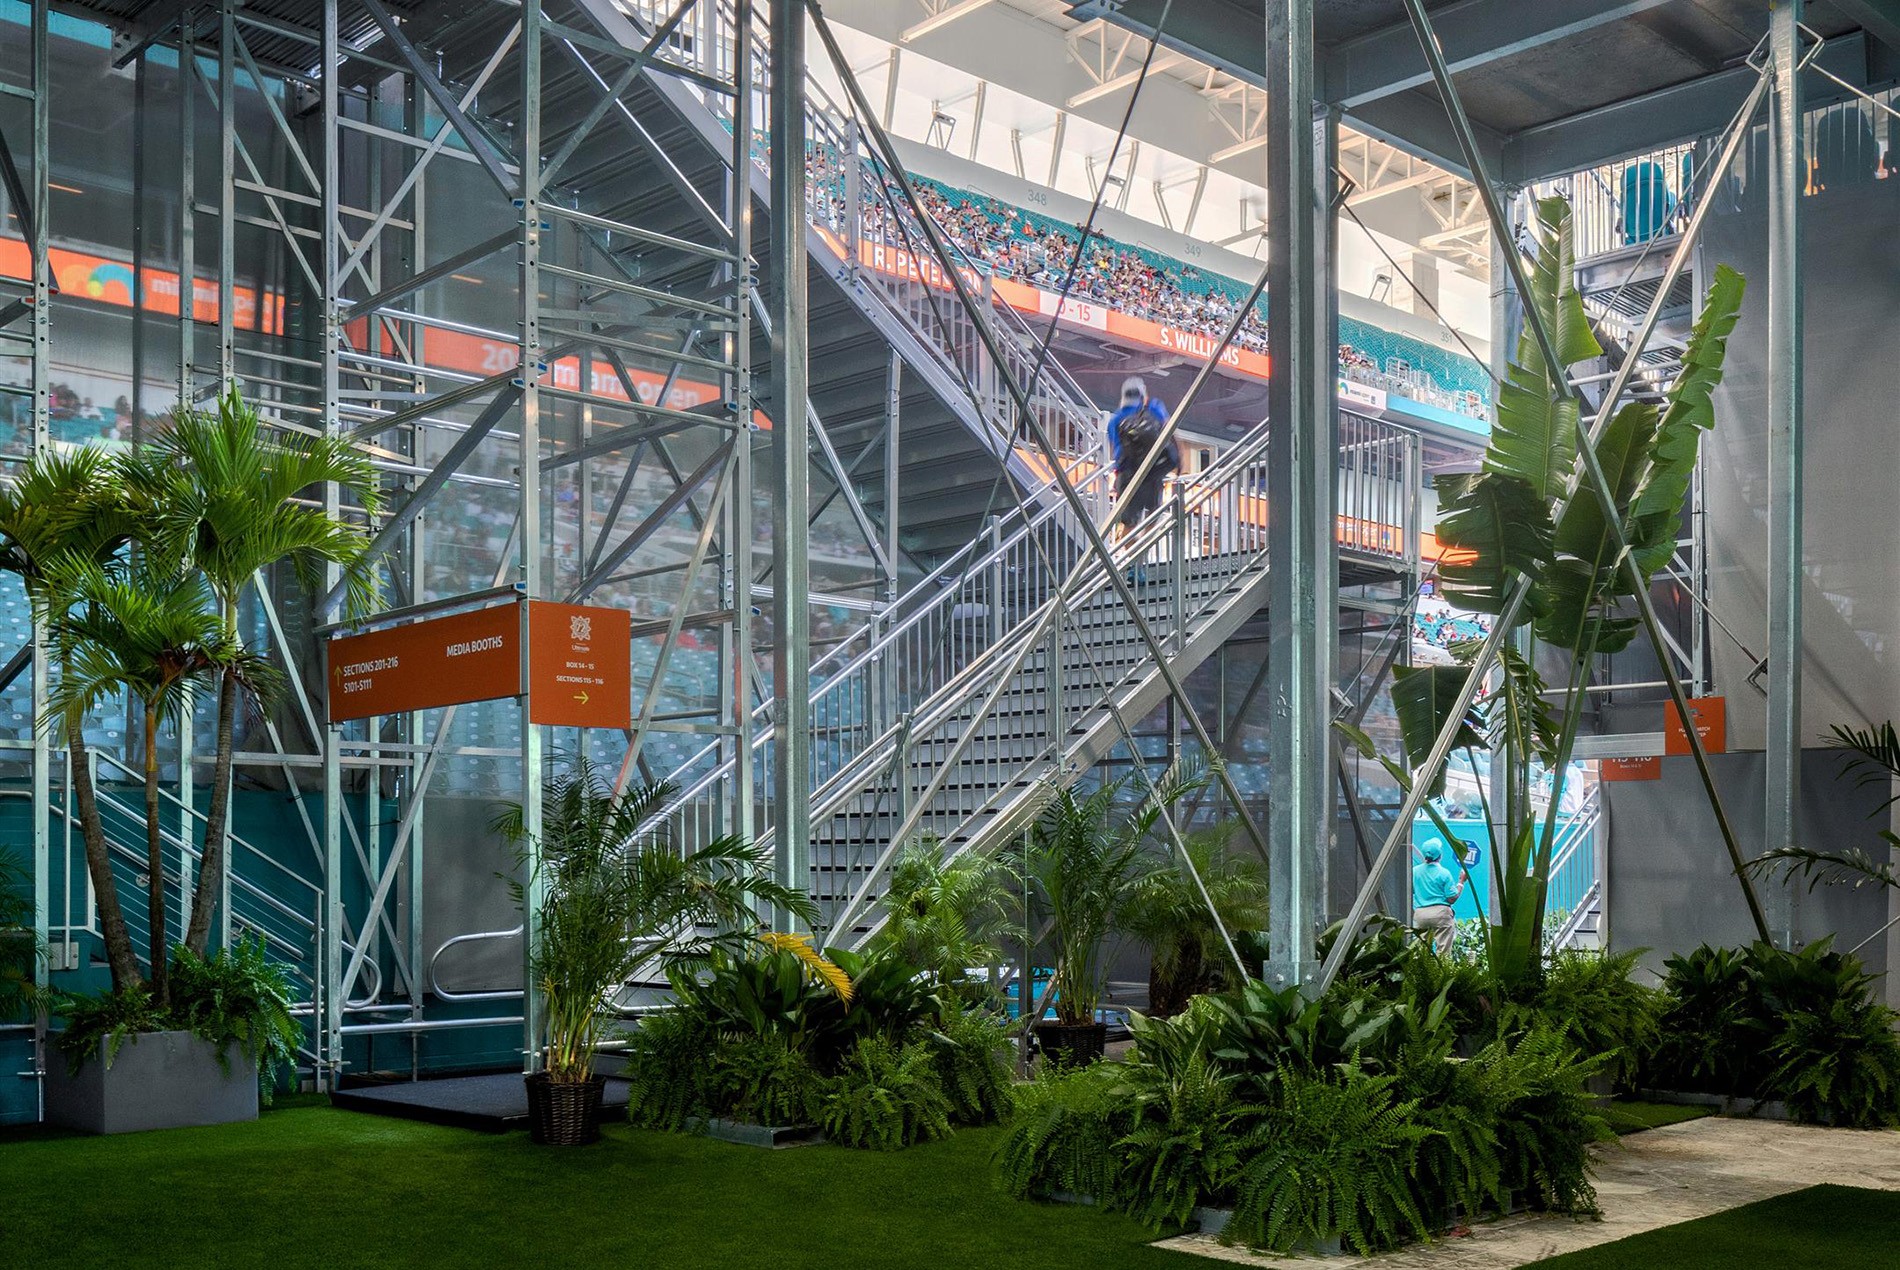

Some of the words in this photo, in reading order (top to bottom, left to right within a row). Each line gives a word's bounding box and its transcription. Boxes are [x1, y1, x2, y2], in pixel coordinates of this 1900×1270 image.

[1027, 188, 1047, 207] 348
[1184, 242, 1202, 259] 349
[874, 244, 892, 271] R.
[897, 250, 982, 294] PETEON
[1077, 303, 1091, 321] 15
[1160, 327, 1173, 347] S.
[446, 642, 471, 657] MEDIA
[471, 635, 503, 653] BOOTHS
[343, 661, 374, 677] SECTIONS
[374, 656, 399, 671] 201-216
[566, 661, 578, 669] BOX
[343, 678, 372, 694] S101-S111
[556, 674, 583, 684] SECTIONS
